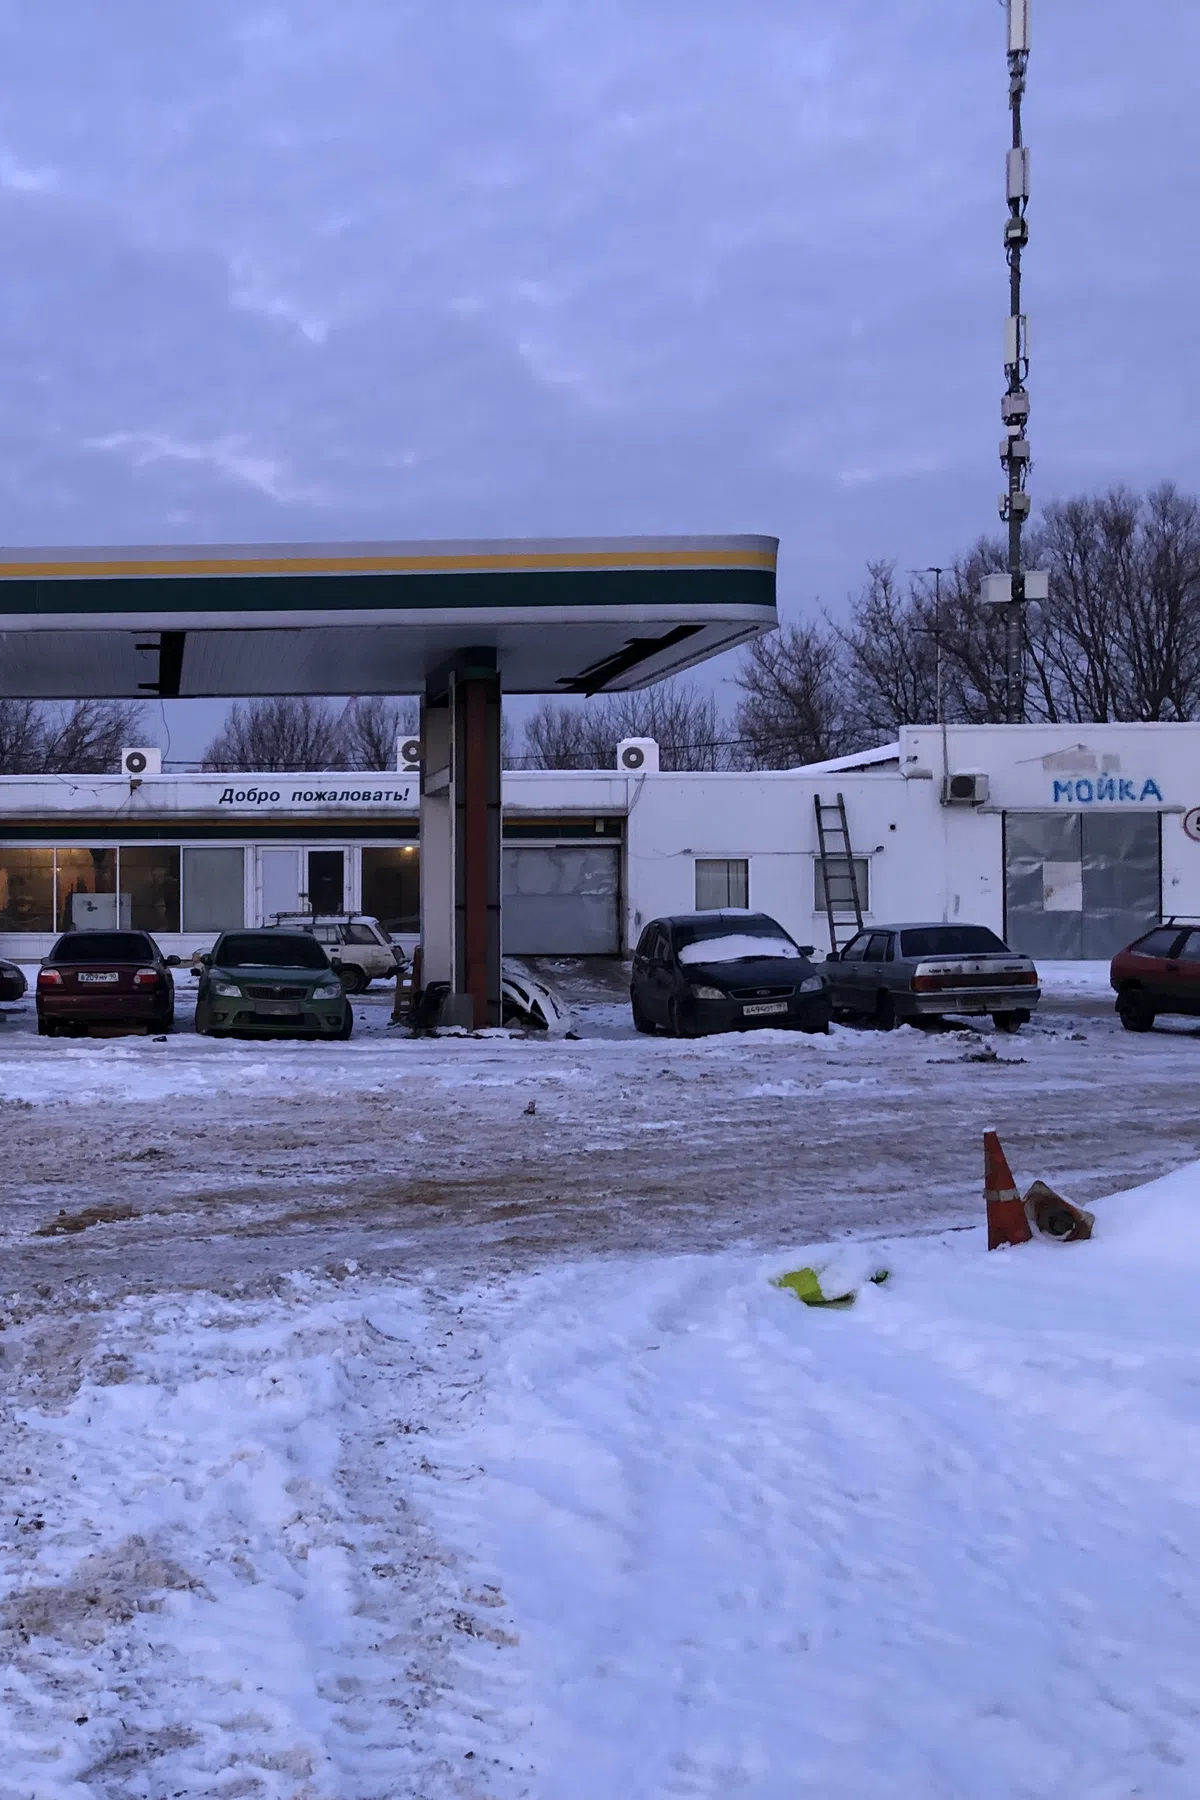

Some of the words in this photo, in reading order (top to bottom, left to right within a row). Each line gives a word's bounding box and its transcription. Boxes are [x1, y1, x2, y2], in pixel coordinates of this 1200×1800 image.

[218, 788, 281, 805] Добро
[291, 788, 410, 802] пожаловать!
[1053, 772, 1163, 803] МОЙКА
